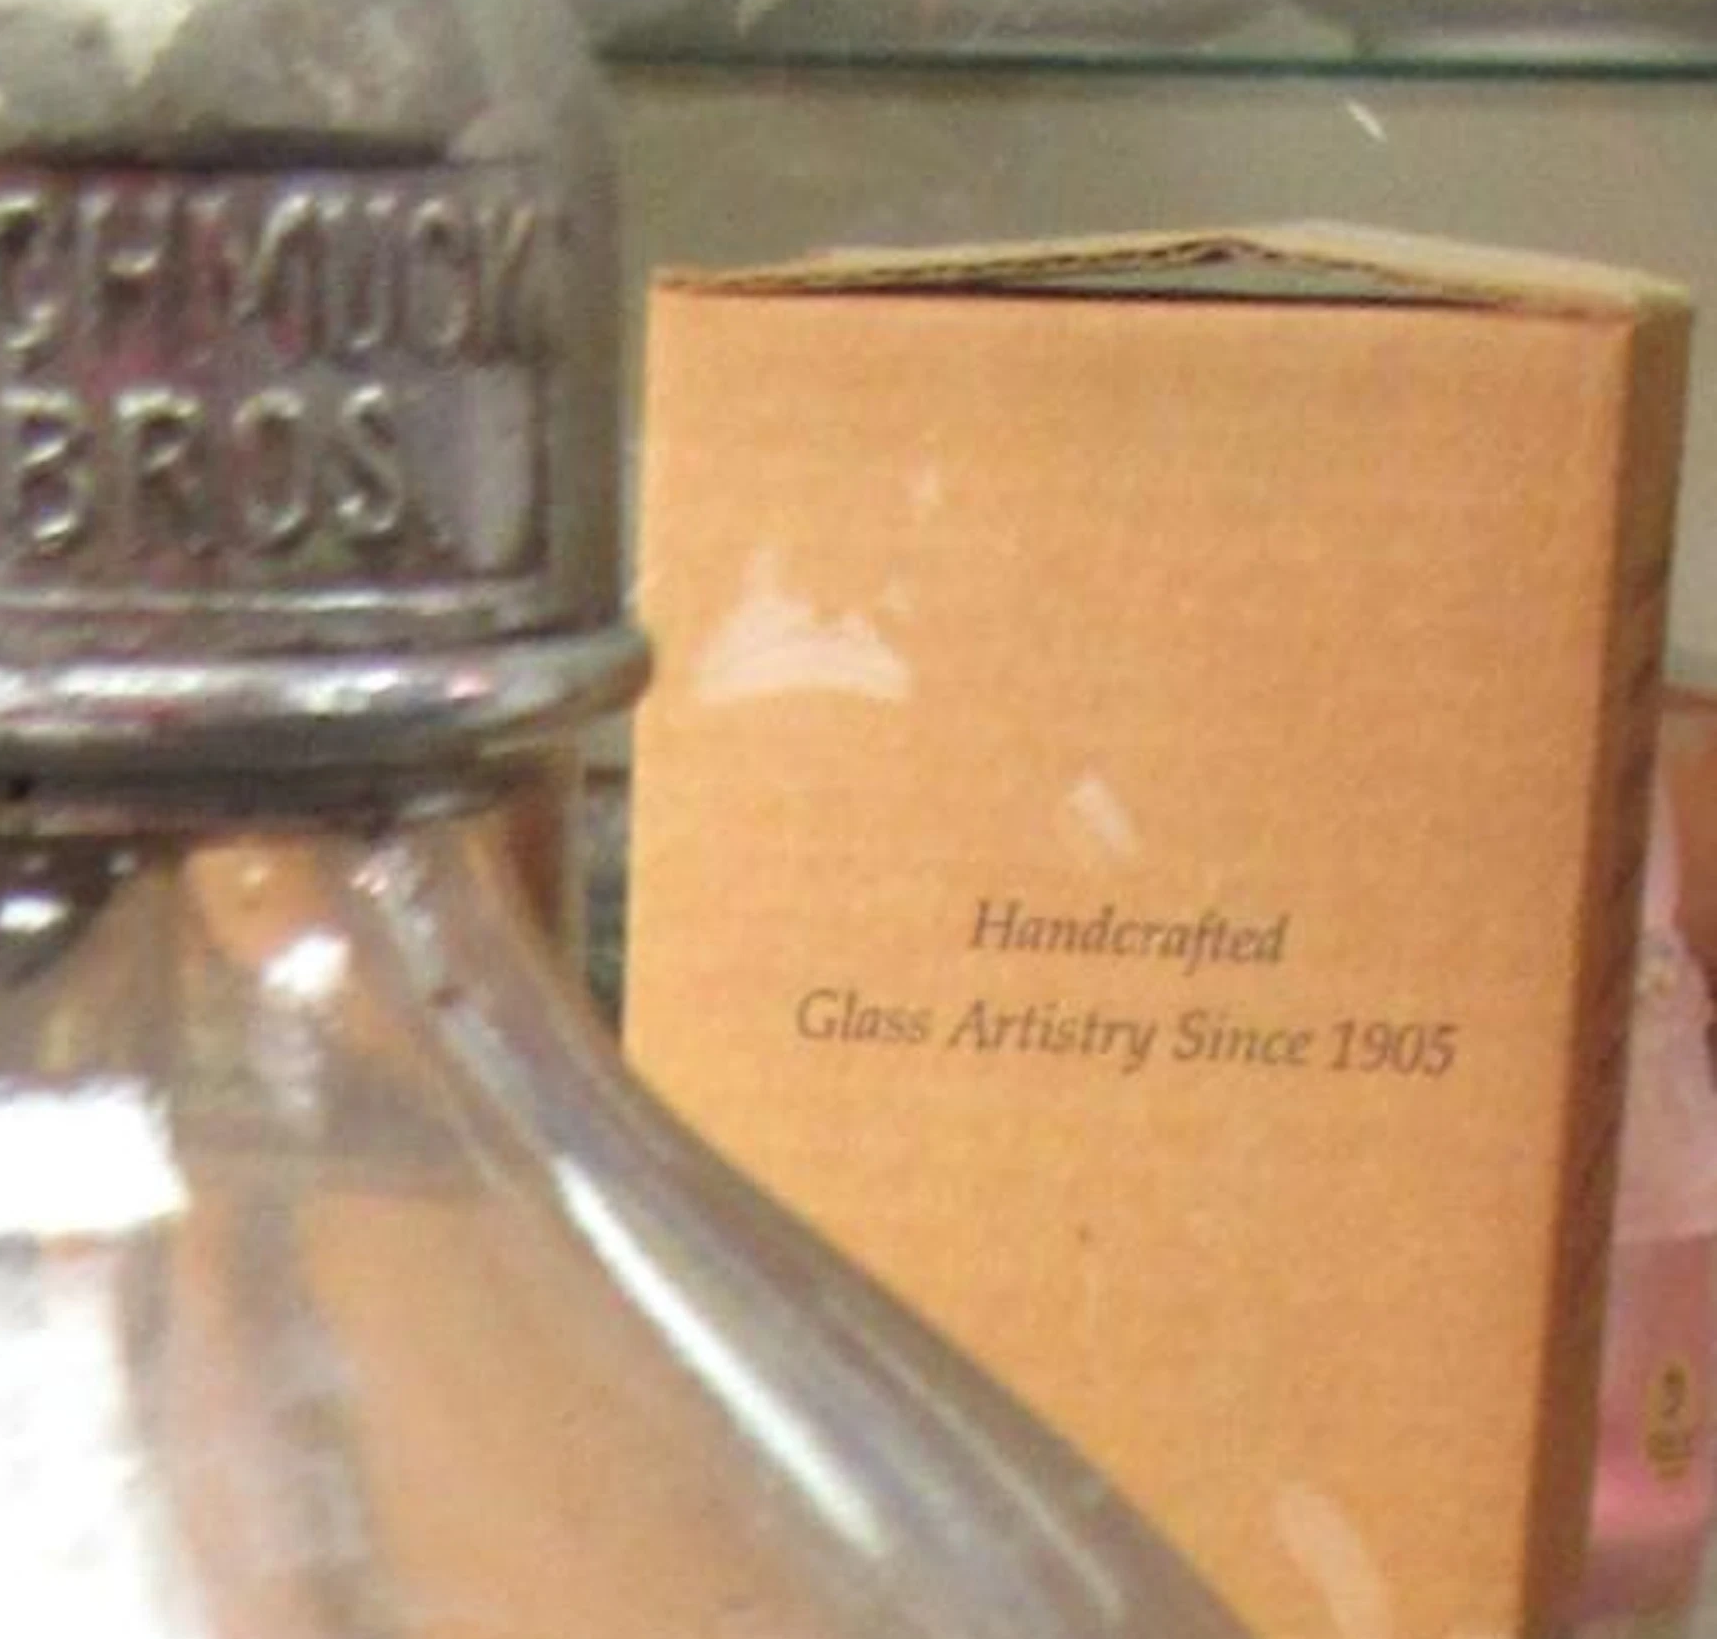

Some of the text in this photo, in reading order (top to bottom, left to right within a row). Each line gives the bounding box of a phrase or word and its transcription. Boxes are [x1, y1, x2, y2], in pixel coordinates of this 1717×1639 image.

[969, 898, 1290, 976] Handcrafted
[795, 988, 1458, 1078] Glass Artistry Since 1905
